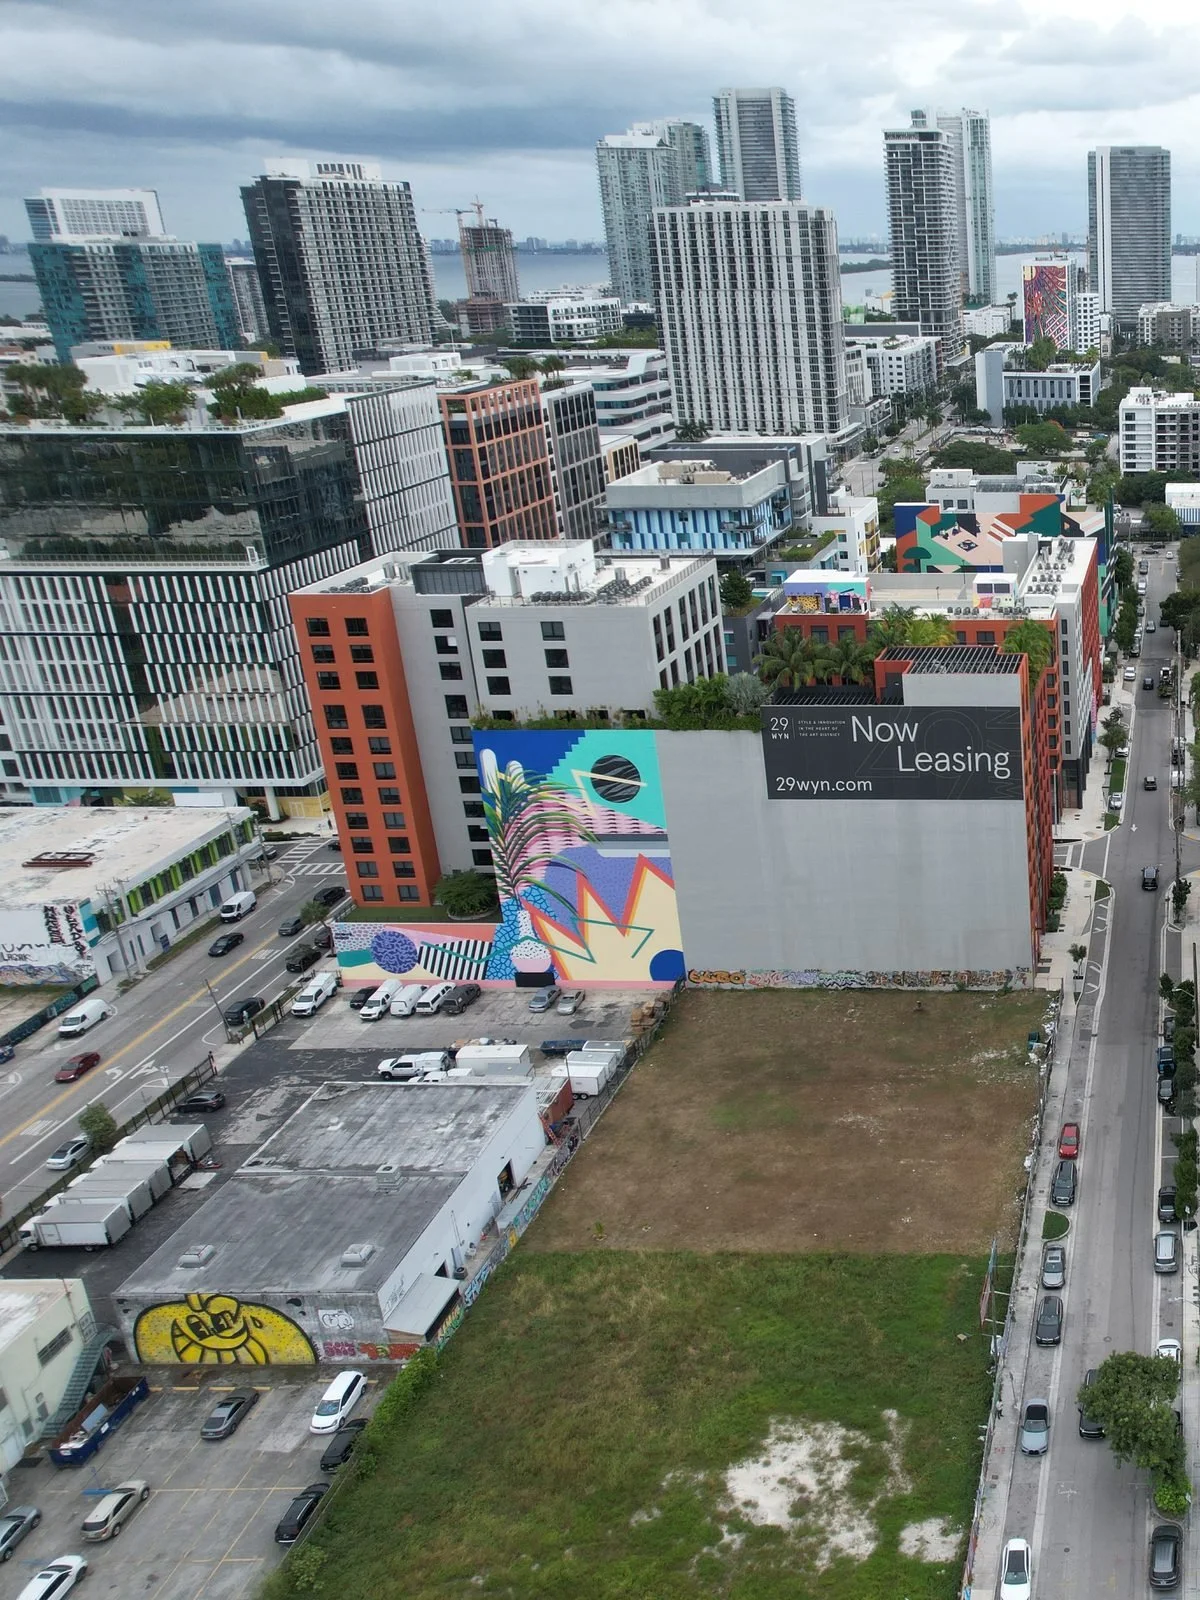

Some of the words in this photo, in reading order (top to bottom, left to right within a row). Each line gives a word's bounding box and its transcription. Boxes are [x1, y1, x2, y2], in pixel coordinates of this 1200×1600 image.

[770, 717, 789, 731] 29
[851, 715, 919, 743] Now
[897, 745, 1012, 779] Leasing
[775, 776, 873, 795] 29wyn.com
